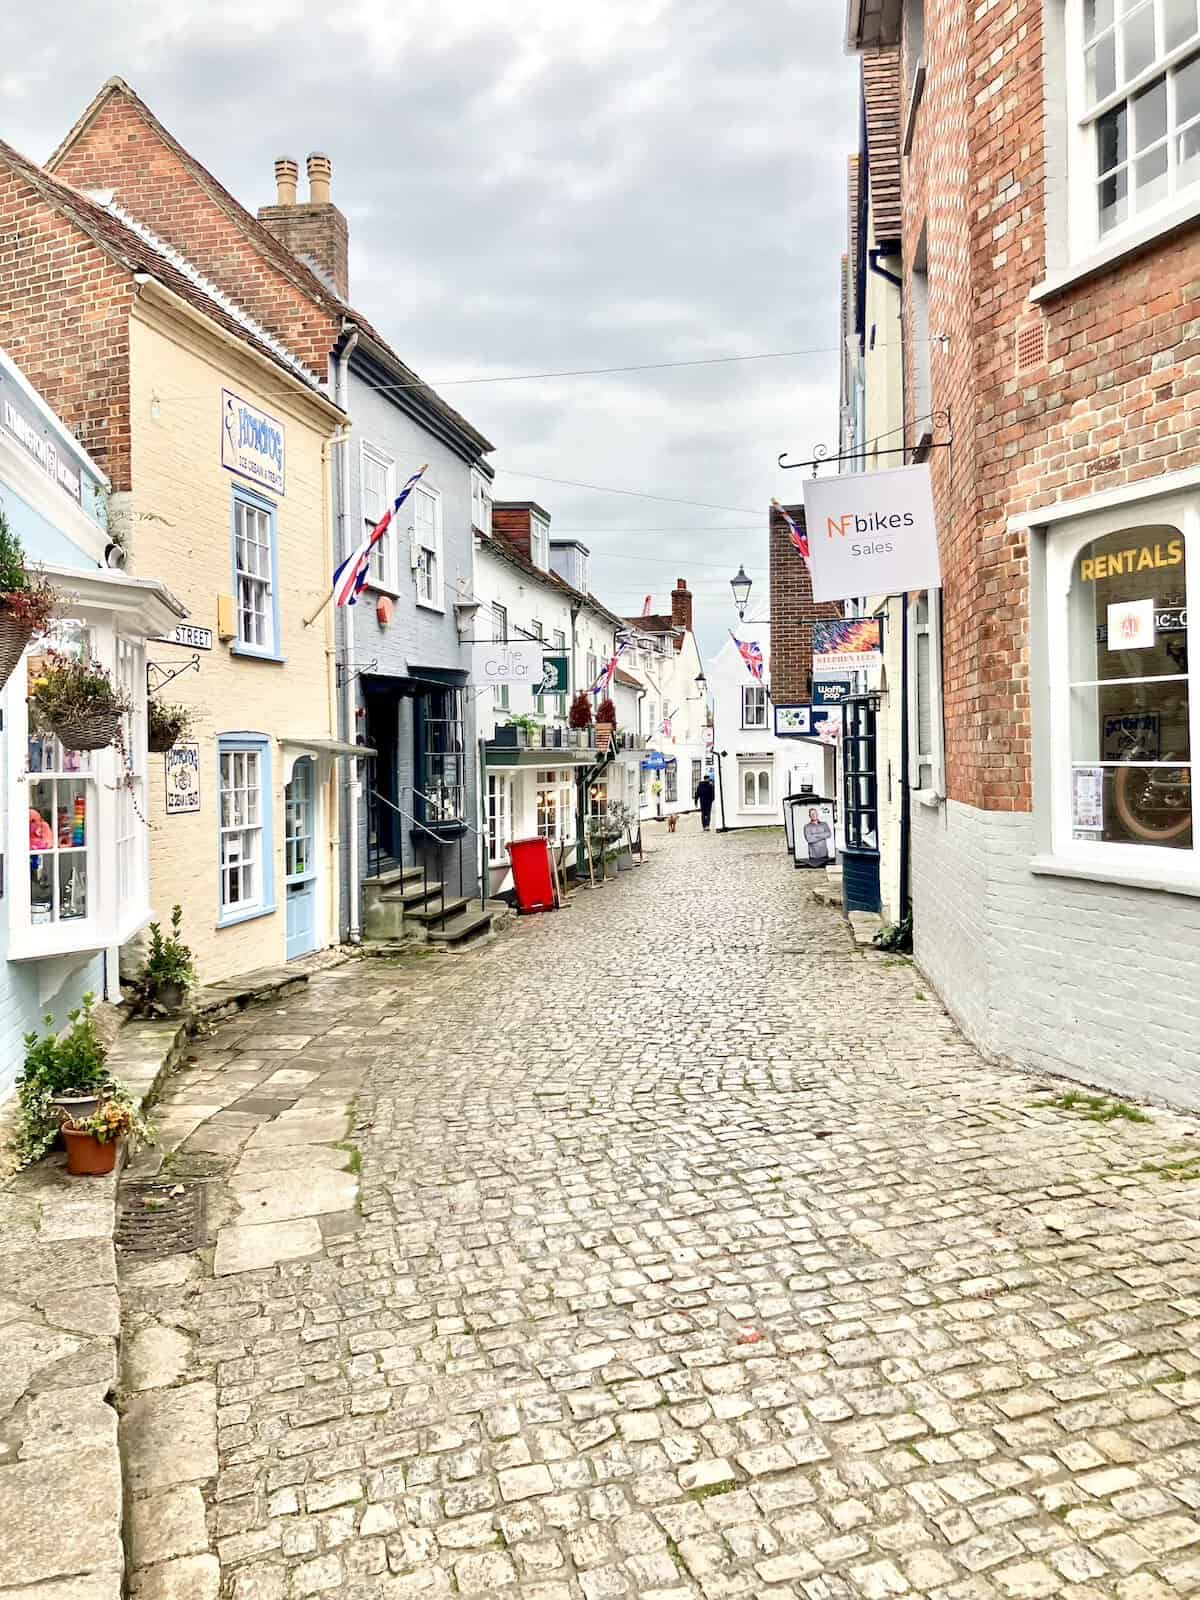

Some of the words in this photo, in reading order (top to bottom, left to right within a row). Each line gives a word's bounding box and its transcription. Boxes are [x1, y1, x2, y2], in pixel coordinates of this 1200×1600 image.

[827, 511, 914, 539] NFbikes
[851, 541, 894, 557] Sales
[1081, 541, 1183, 581] RENTALS
[175, 626, 209, 646] STREET
[499, 649, 522, 660] The
[816, 656, 854, 665] STEPHEN
[485, 660, 529, 676] Cellar
[818, 685, 846, 694] Waffle
[823, 693, 840, 701] pop
